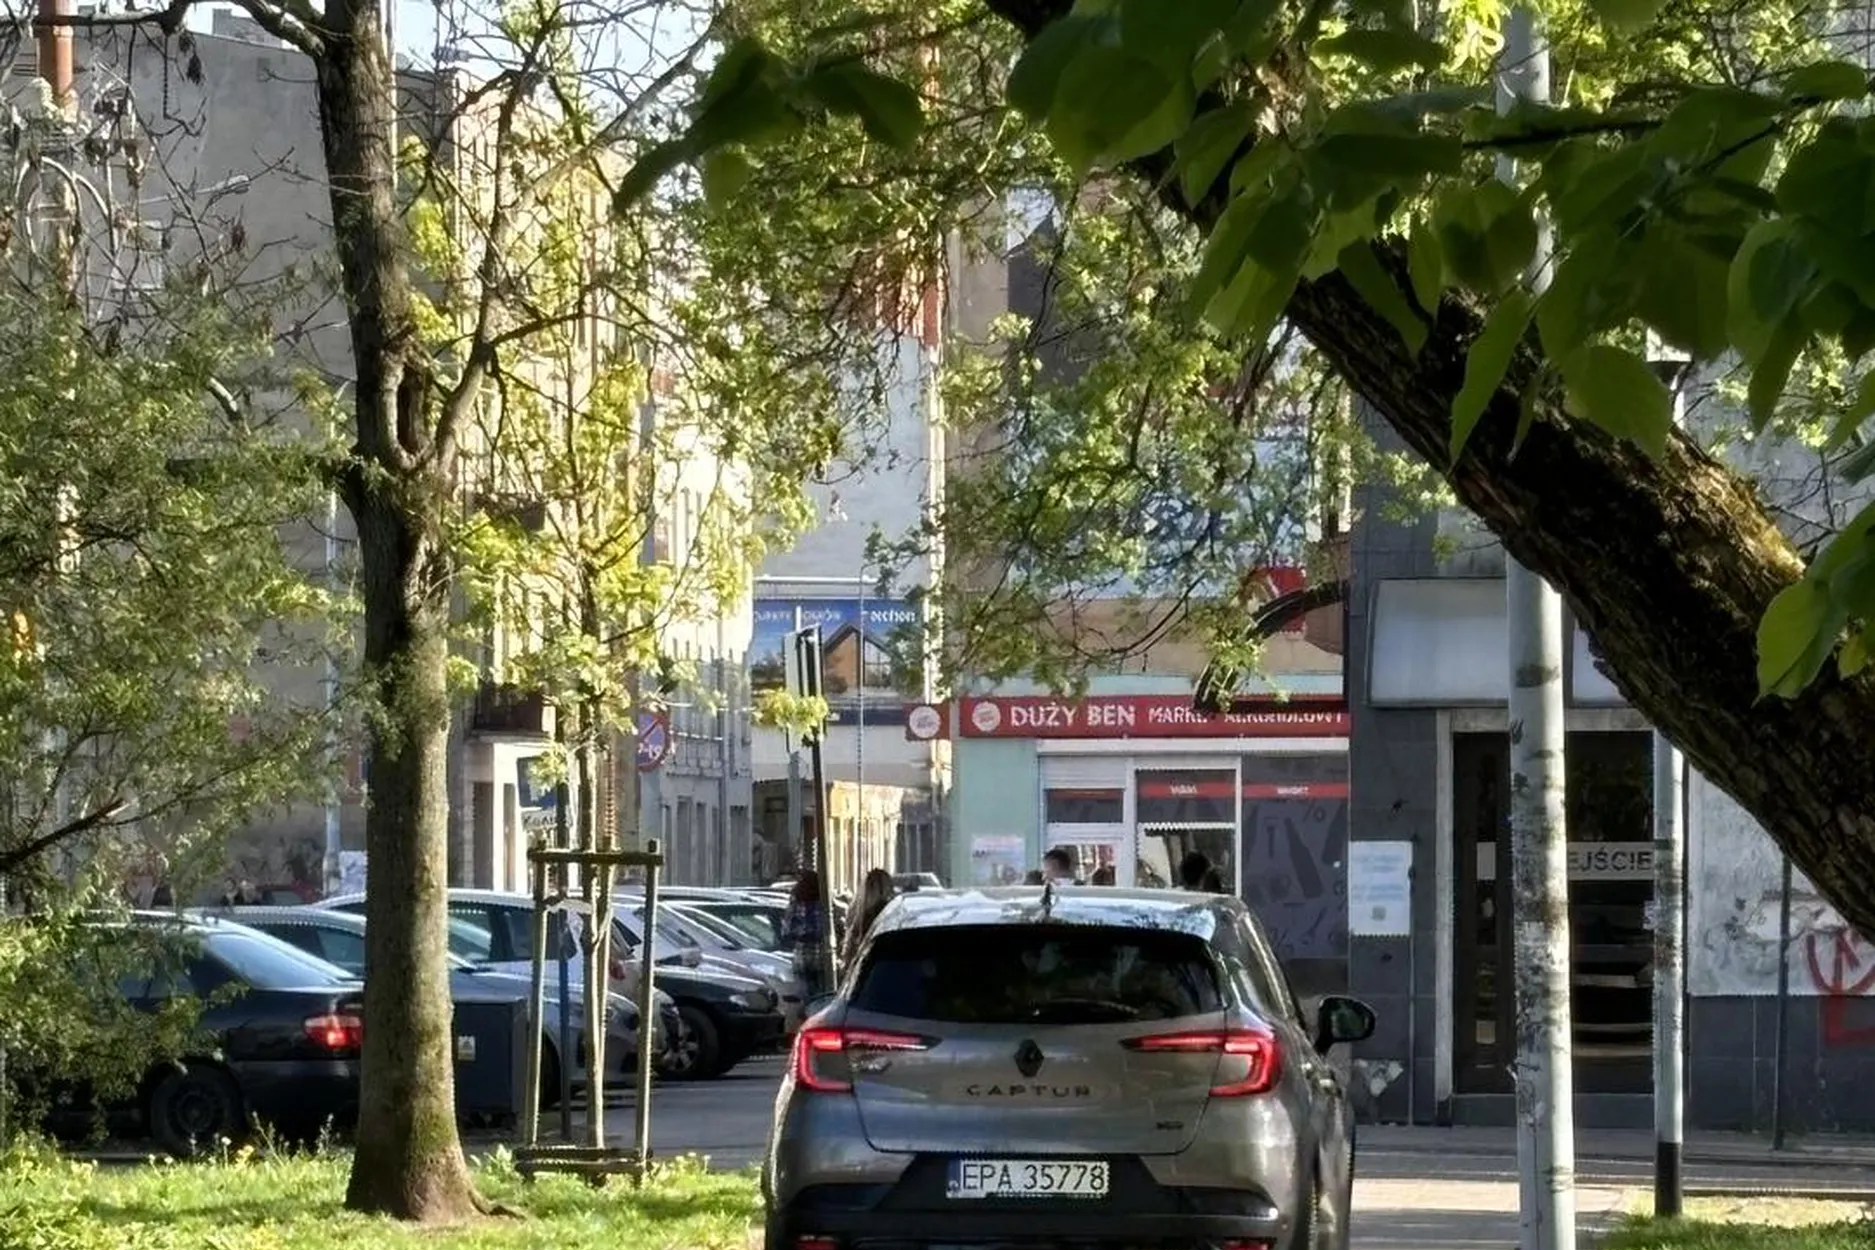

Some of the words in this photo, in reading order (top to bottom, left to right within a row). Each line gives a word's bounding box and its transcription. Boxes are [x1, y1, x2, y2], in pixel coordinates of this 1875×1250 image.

[1010, 702, 1076, 727] DUŻY
[1087, 705, 1136, 727] BEN
[1148, 706, 1208, 724] MARK
[1567, 846, 1653, 871] EJŚCIE
[966, 1084, 1091, 1098] CAPTUR
[962, 1164, 1013, 1190] EPA
[1023, 1164, 1106, 1190] 35778
